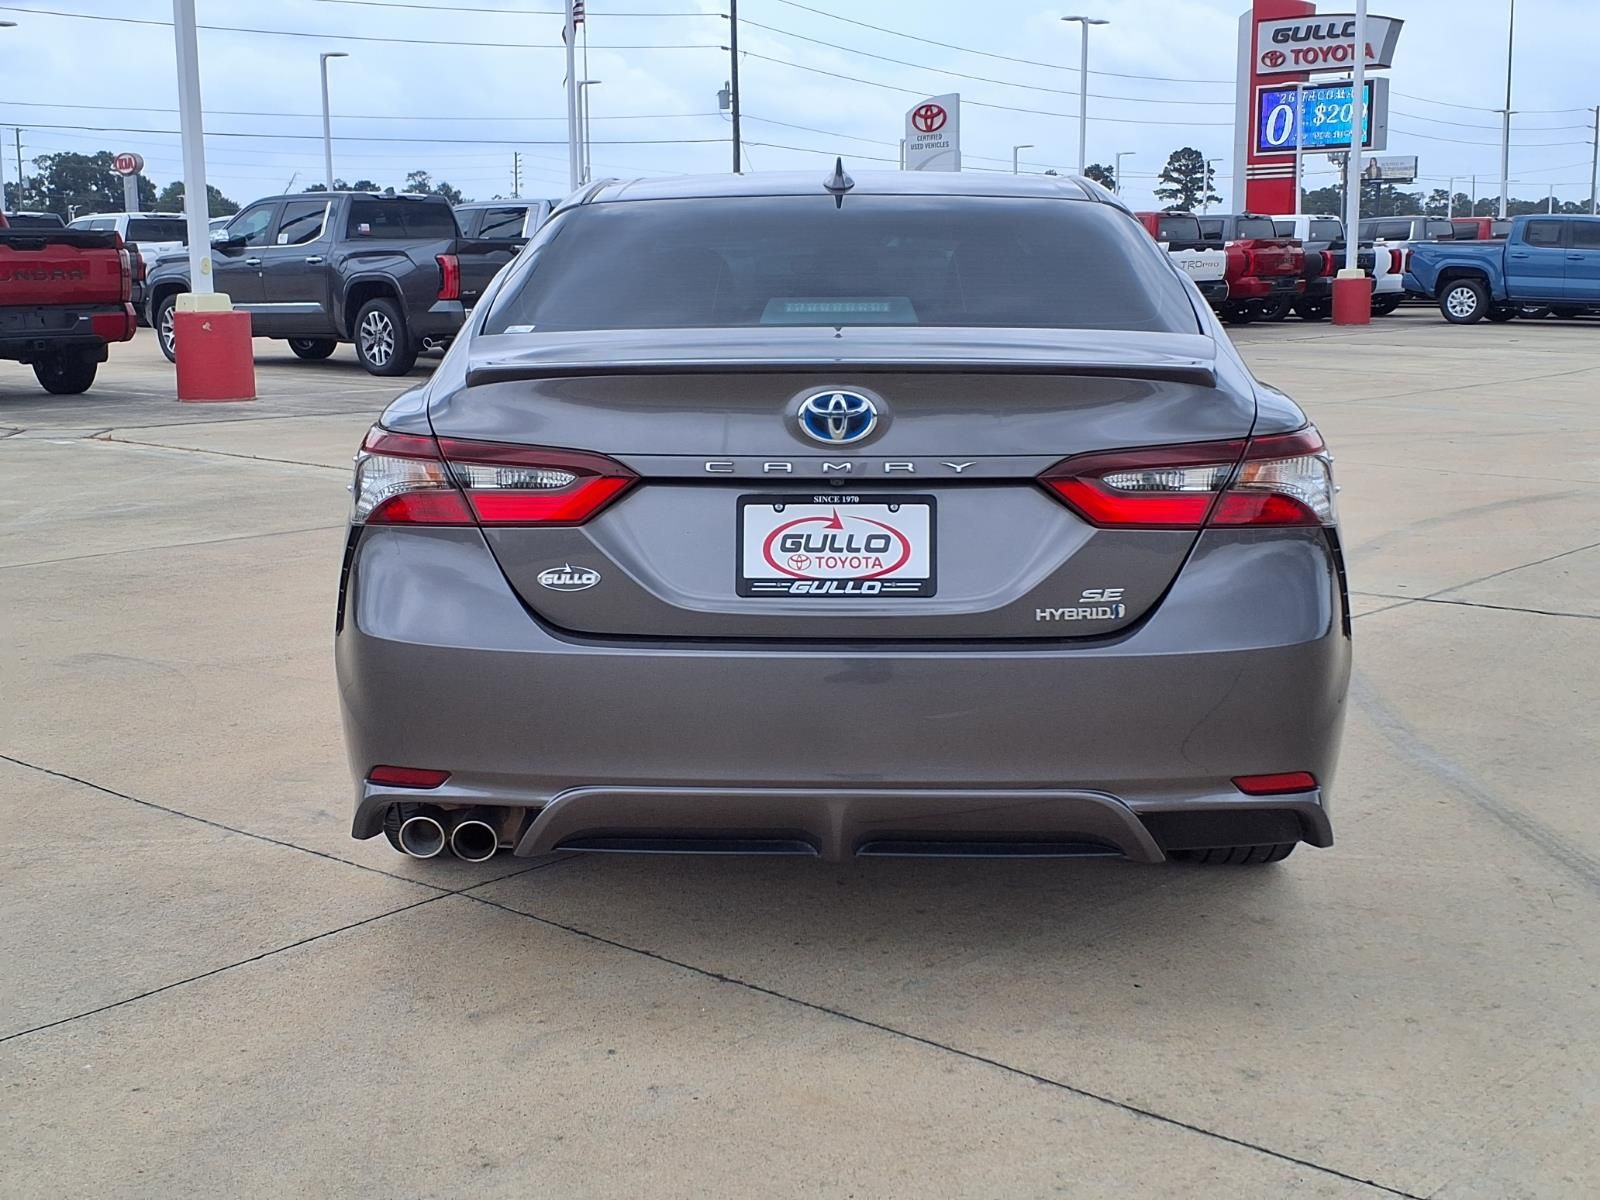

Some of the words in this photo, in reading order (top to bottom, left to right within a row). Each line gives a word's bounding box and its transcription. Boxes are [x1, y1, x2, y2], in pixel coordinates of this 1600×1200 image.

[917, 133, 943, 142] CERTIFIED
[925, 141, 949, 149] VEHICLES
[705, 462, 977, 474] CAMRY
[813, 495, 840, 503] SINCE
[842, 495, 860, 503] 1970
[780, 534, 891, 553] GULLO
[816, 556, 884, 569] TOYOTA
[541, 573, 597, 585] GULLO
[788, 580, 882, 594] GULLO
[1079, 588, 1125, 603] SE
[1035, 607, 1112, 621] HYBRID
